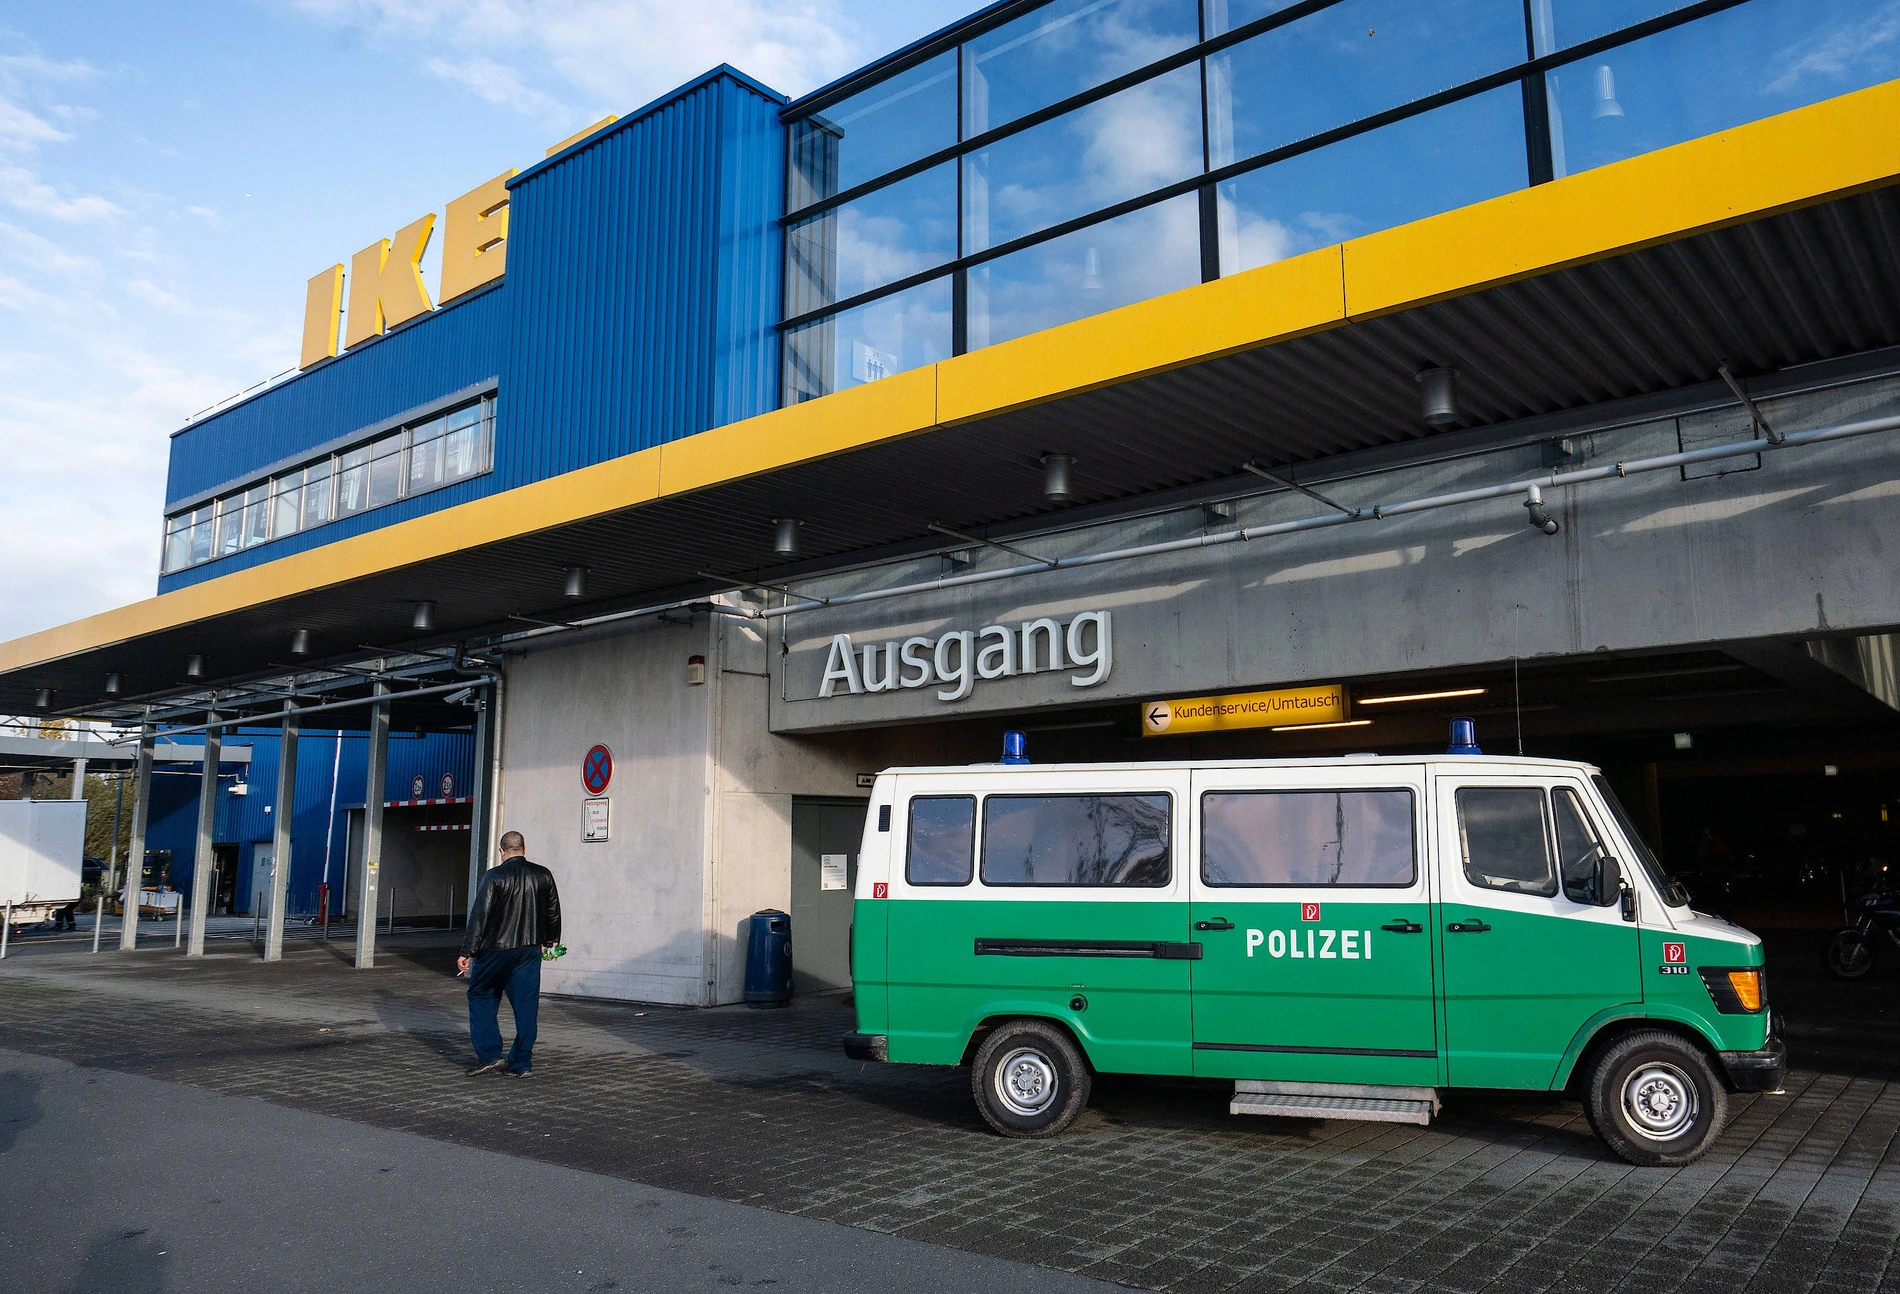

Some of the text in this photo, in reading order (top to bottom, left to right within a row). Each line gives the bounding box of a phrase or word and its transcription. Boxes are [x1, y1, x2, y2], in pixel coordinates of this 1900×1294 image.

[299, 115, 619, 371] IKE
[818, 610, 1112, 700] Ausgang
[1174, 692, 1340, 719] Kundenservice/Umtausch
[1246, 928, 1372, 960] POLIZEI
[1661, 966, 1688, 974] 310
